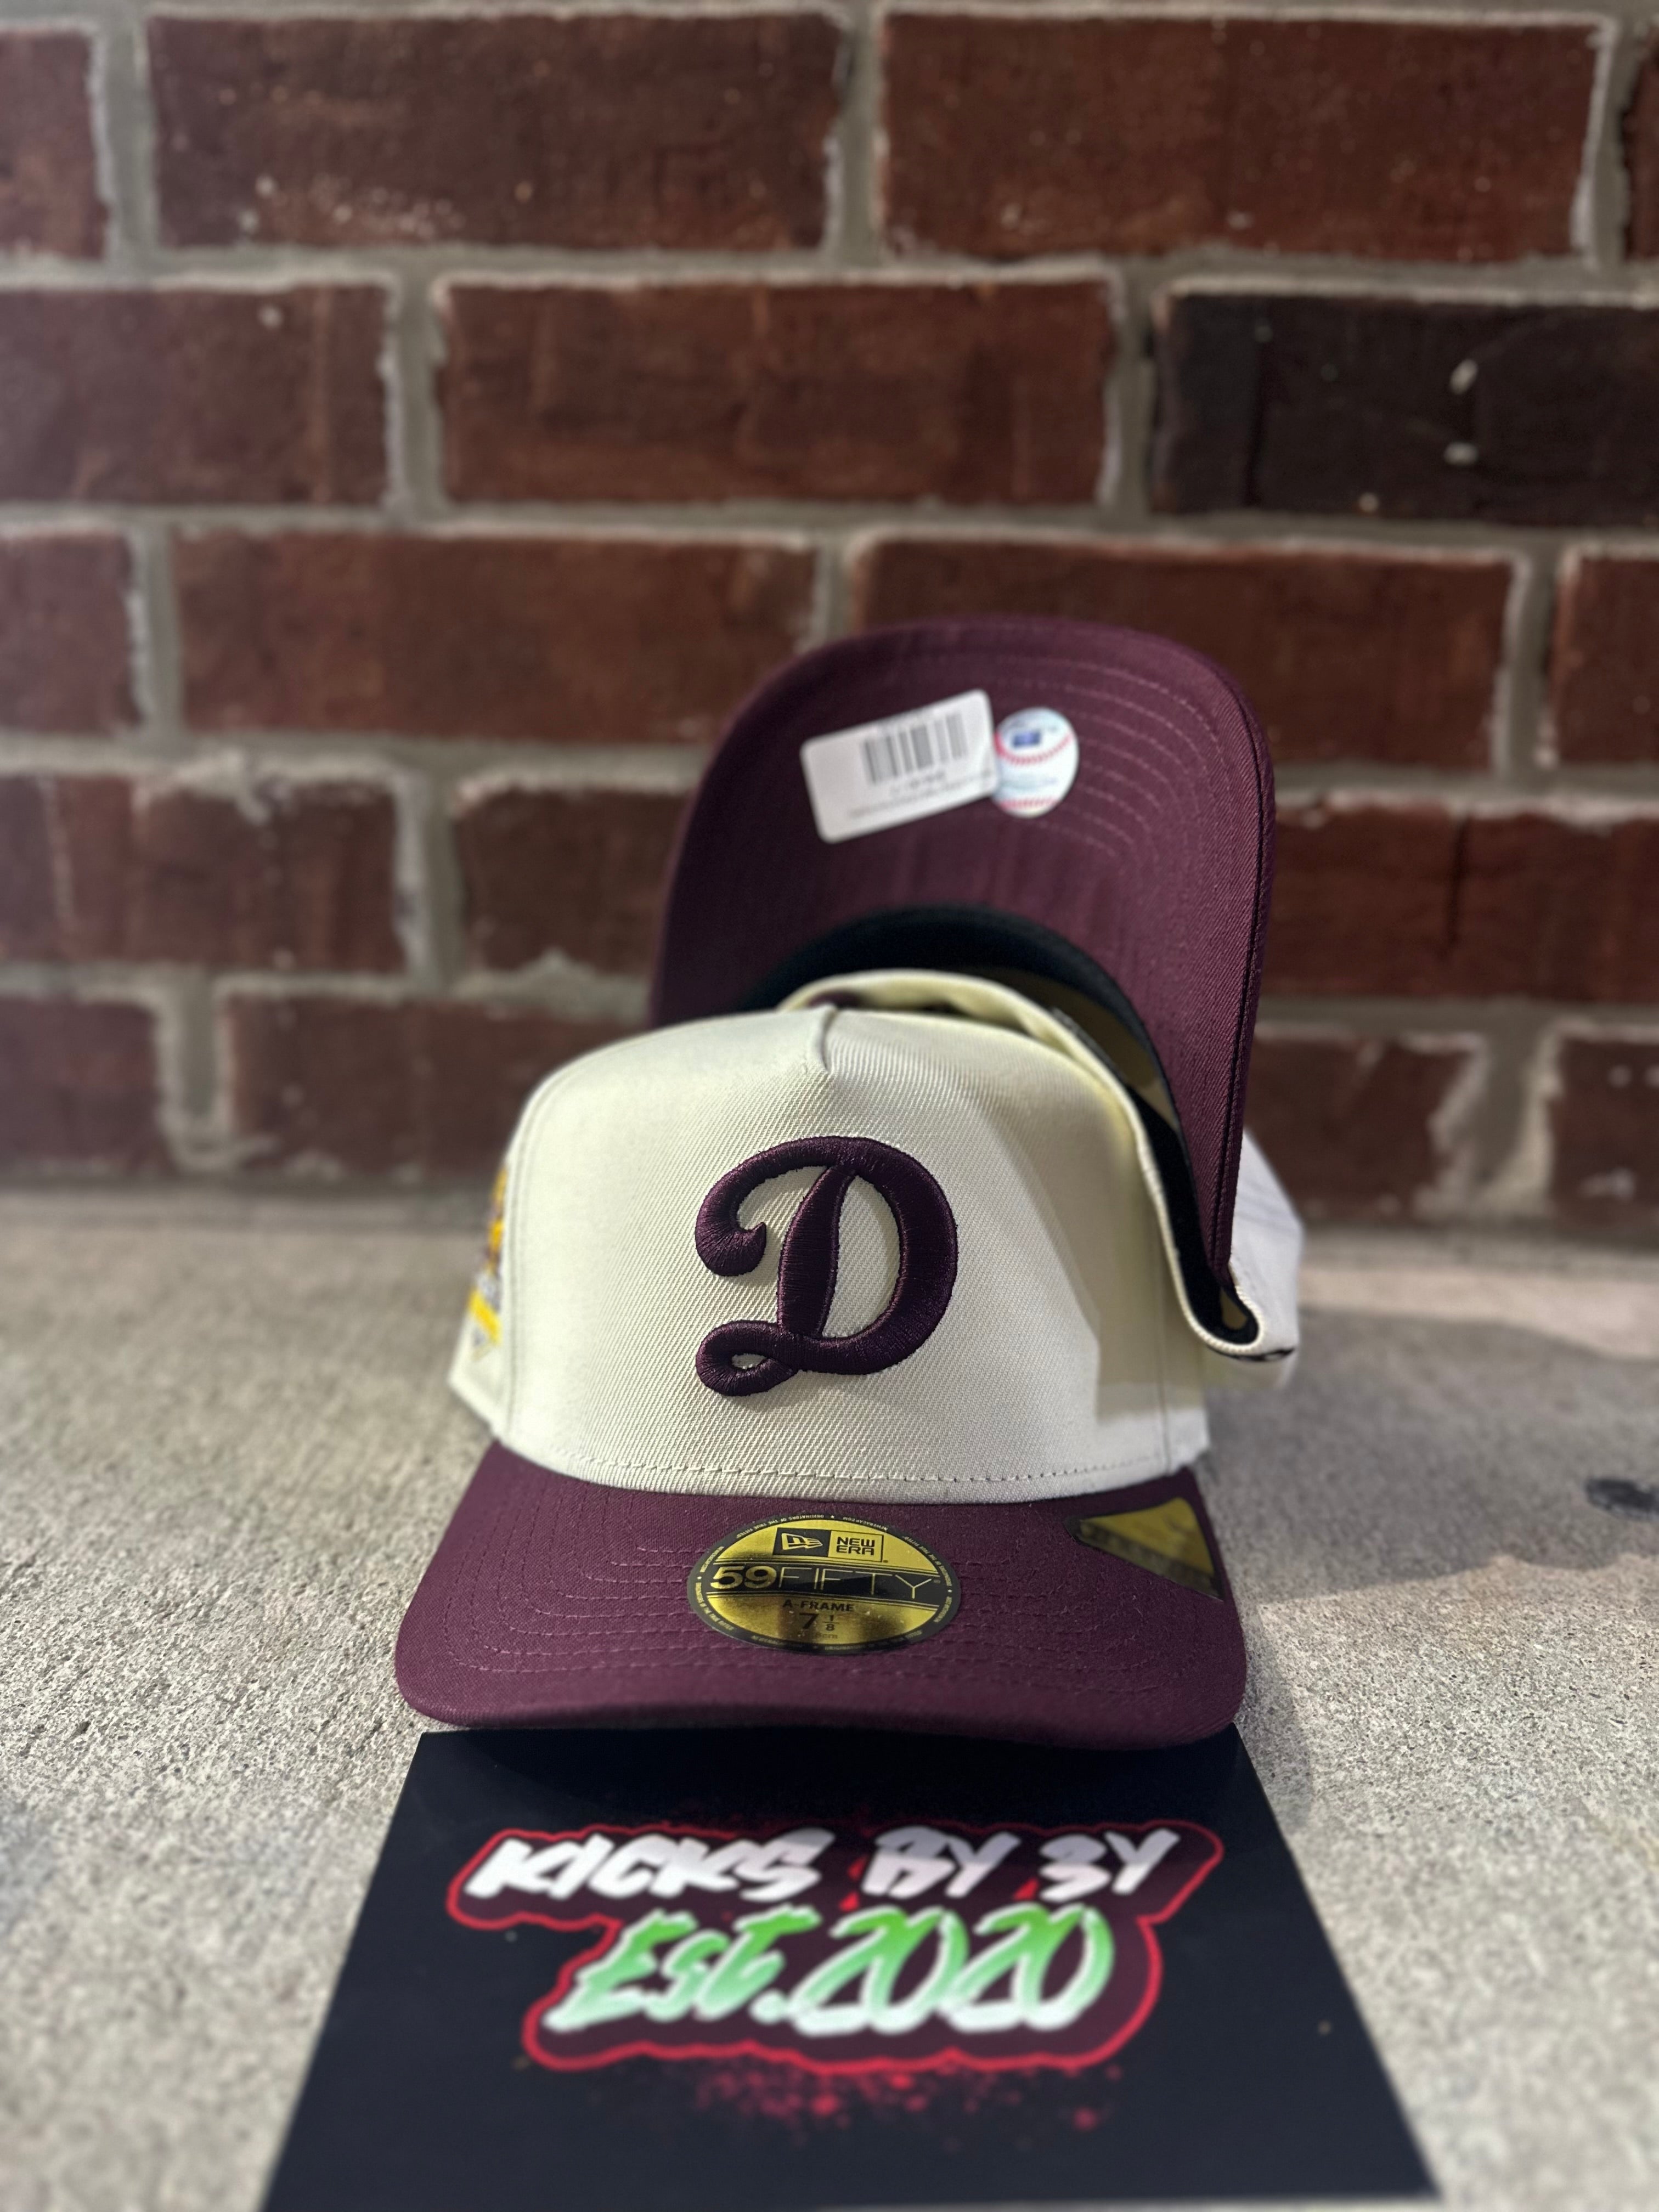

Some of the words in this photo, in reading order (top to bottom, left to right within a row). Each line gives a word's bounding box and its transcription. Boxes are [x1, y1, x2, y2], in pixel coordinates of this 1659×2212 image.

[695, 1135, 958, 1396] D
[836, 1545, 874, 1555] ERA
[837, 1536, 875, 1548] NEW
[710, 1565, 932, 1599] 59FIFTY
[782, 1599, 855, 1612] A-FRAME
[799, 1612, 820, 1629] 7
[464, 1827, 836, 1902] KICKS
[860, 1825, 1022, 1900] BY
